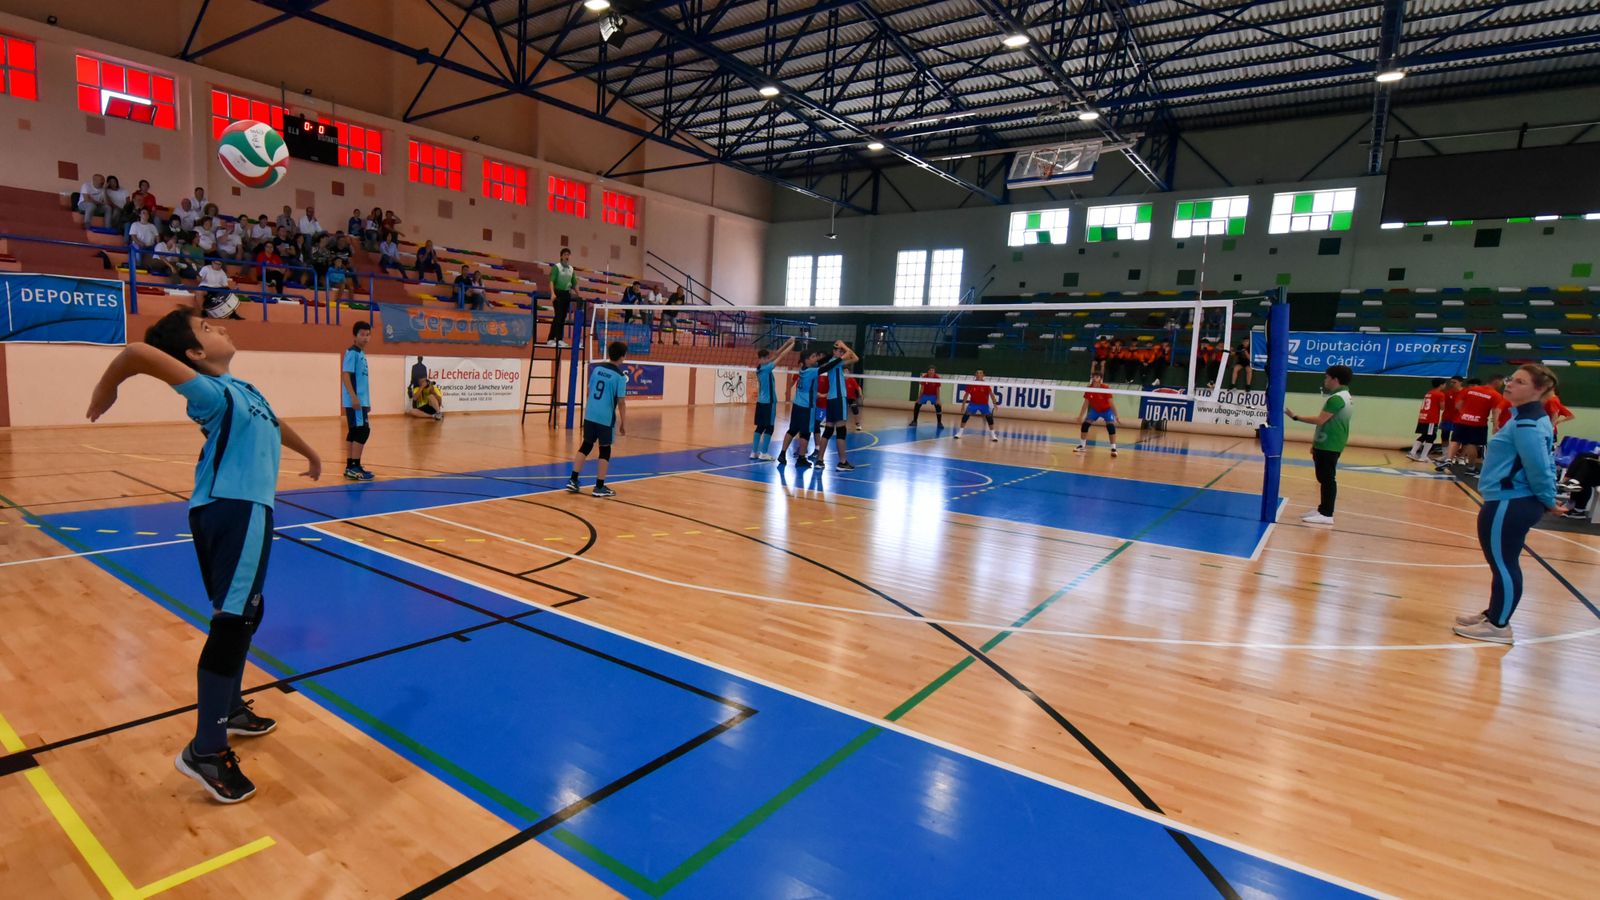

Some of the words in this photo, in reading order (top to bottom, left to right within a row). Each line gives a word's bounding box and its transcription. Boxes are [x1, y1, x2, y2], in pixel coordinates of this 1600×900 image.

[21, 287, 118, 307] DEPORTES
[1306, 339, 1381, 352] Diputación
[1395, 343, 1467, 354] DEPORTES
[1304, 355, 1321, 366] de
[1326, 354, 1366, 368] Cádiz
[428, 369, 439, 380] La
[482, 369, 493, 380] de
[495, 369, 519, 383] Diego
[593, 380, 606, 400] 9
[1237, 391, 1267, 406] GROU
[1145, 404, 1186, 421] UBAGO
